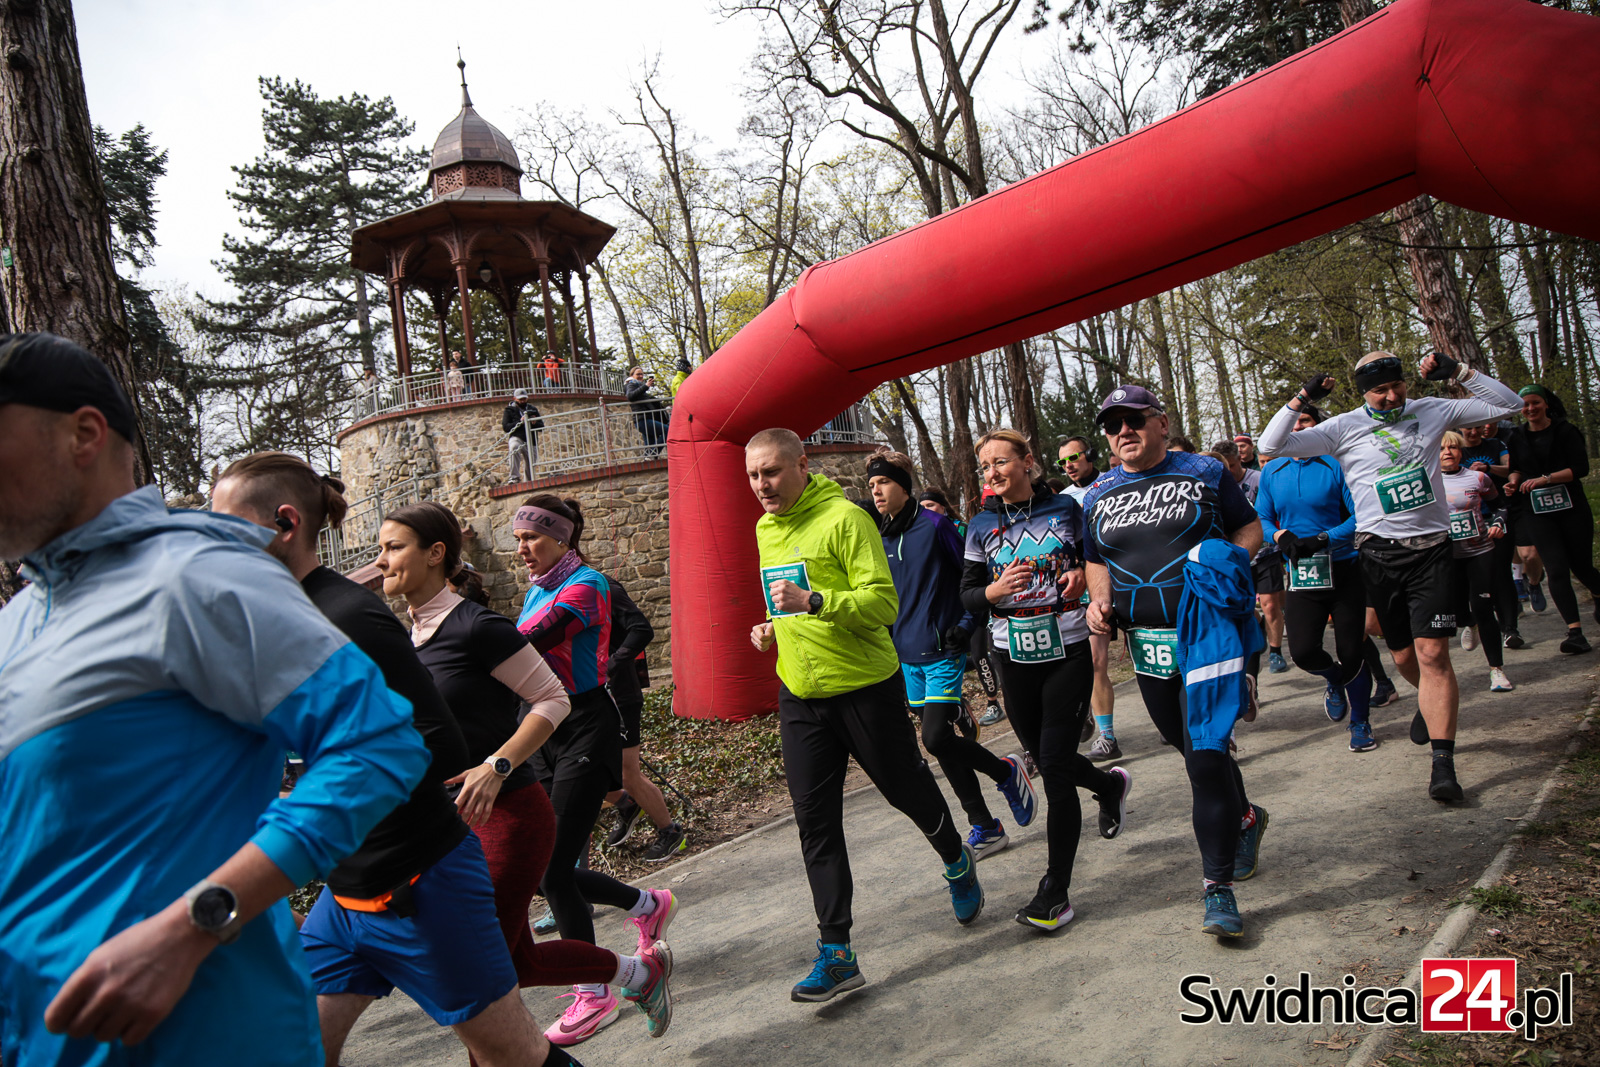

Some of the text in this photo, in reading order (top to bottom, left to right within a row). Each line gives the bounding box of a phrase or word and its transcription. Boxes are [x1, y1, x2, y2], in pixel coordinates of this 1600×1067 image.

[1092, 481, 1205, 523] PREDATORS
[1387, 480, 1426, 504] 122
[1537, 493, 1564, 507] 156
[516, 511, 556, 527] RUN
[1448, 519, 1472, 534] 63
[1298, 566, 1320, 580] 54
[1013, 629, 1052, 652] 189
[1142, 643, 1173, 667] 36
[979, 658, 995, 693] adidas
